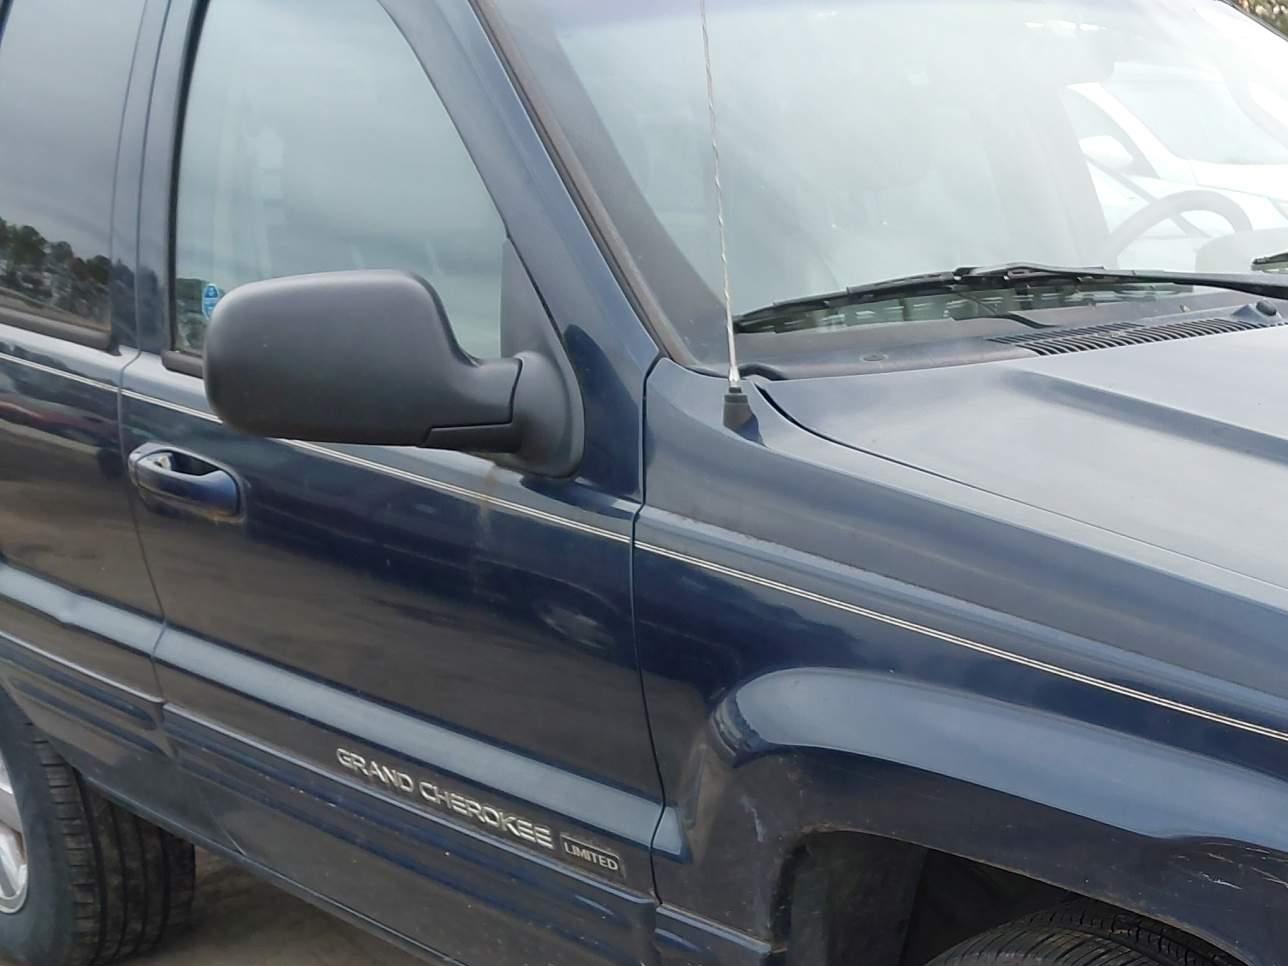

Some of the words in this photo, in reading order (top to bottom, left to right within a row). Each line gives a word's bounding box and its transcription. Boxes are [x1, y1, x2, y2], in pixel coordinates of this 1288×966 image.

[336, 748, 415, 793] GRAND
[419, 781, 554, 849] CHEROKEE
[563, 840, 619, 872] LIMITED
